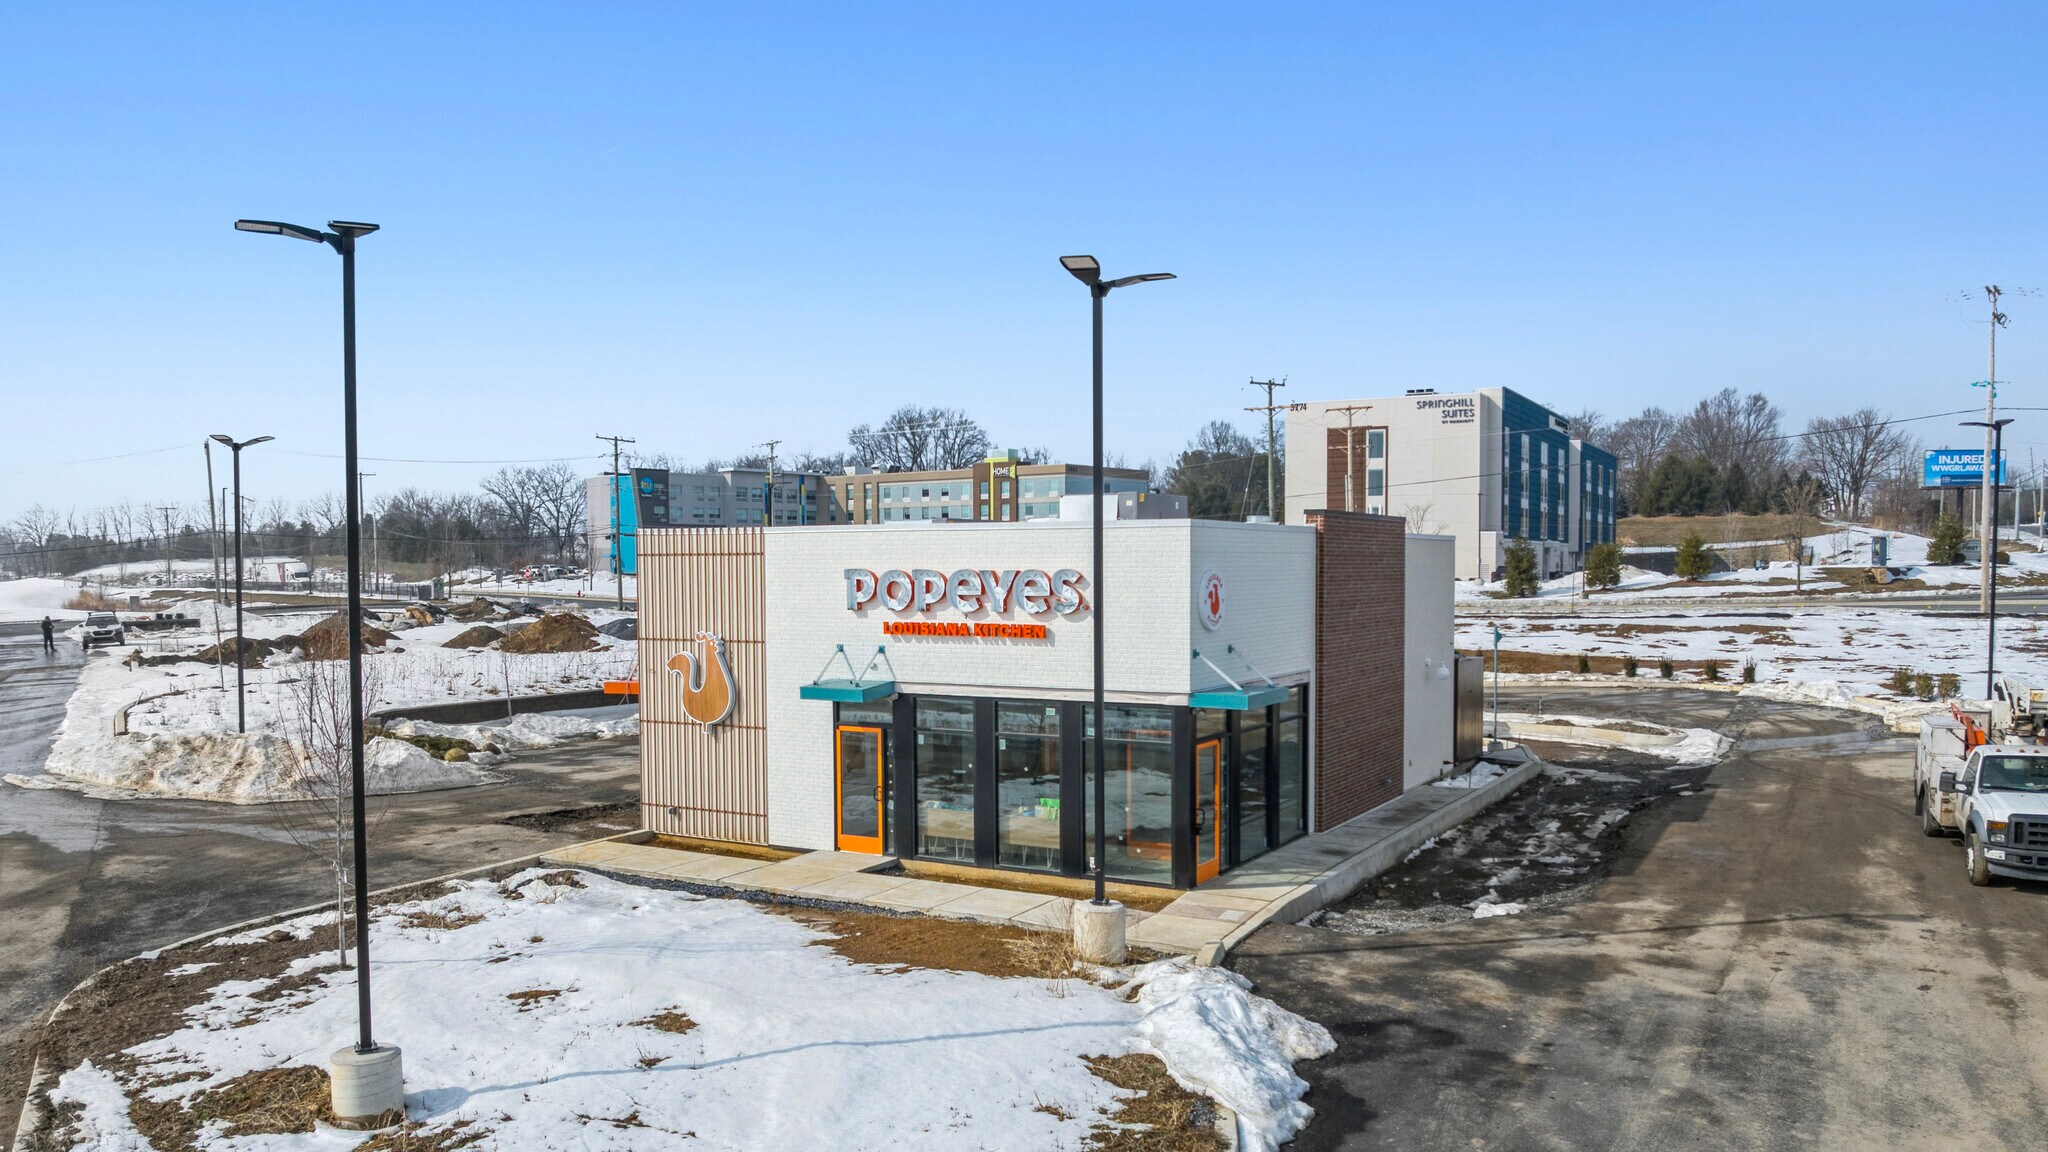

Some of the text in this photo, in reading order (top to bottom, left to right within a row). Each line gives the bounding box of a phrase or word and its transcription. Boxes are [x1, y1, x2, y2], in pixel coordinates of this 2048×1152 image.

[1416, 398, 1475, 410] SPRINGHILL
[1441, 409, 1475, 419] SUITES
[883, 621, 1046, 639] LOUISIANA KITCHEN
